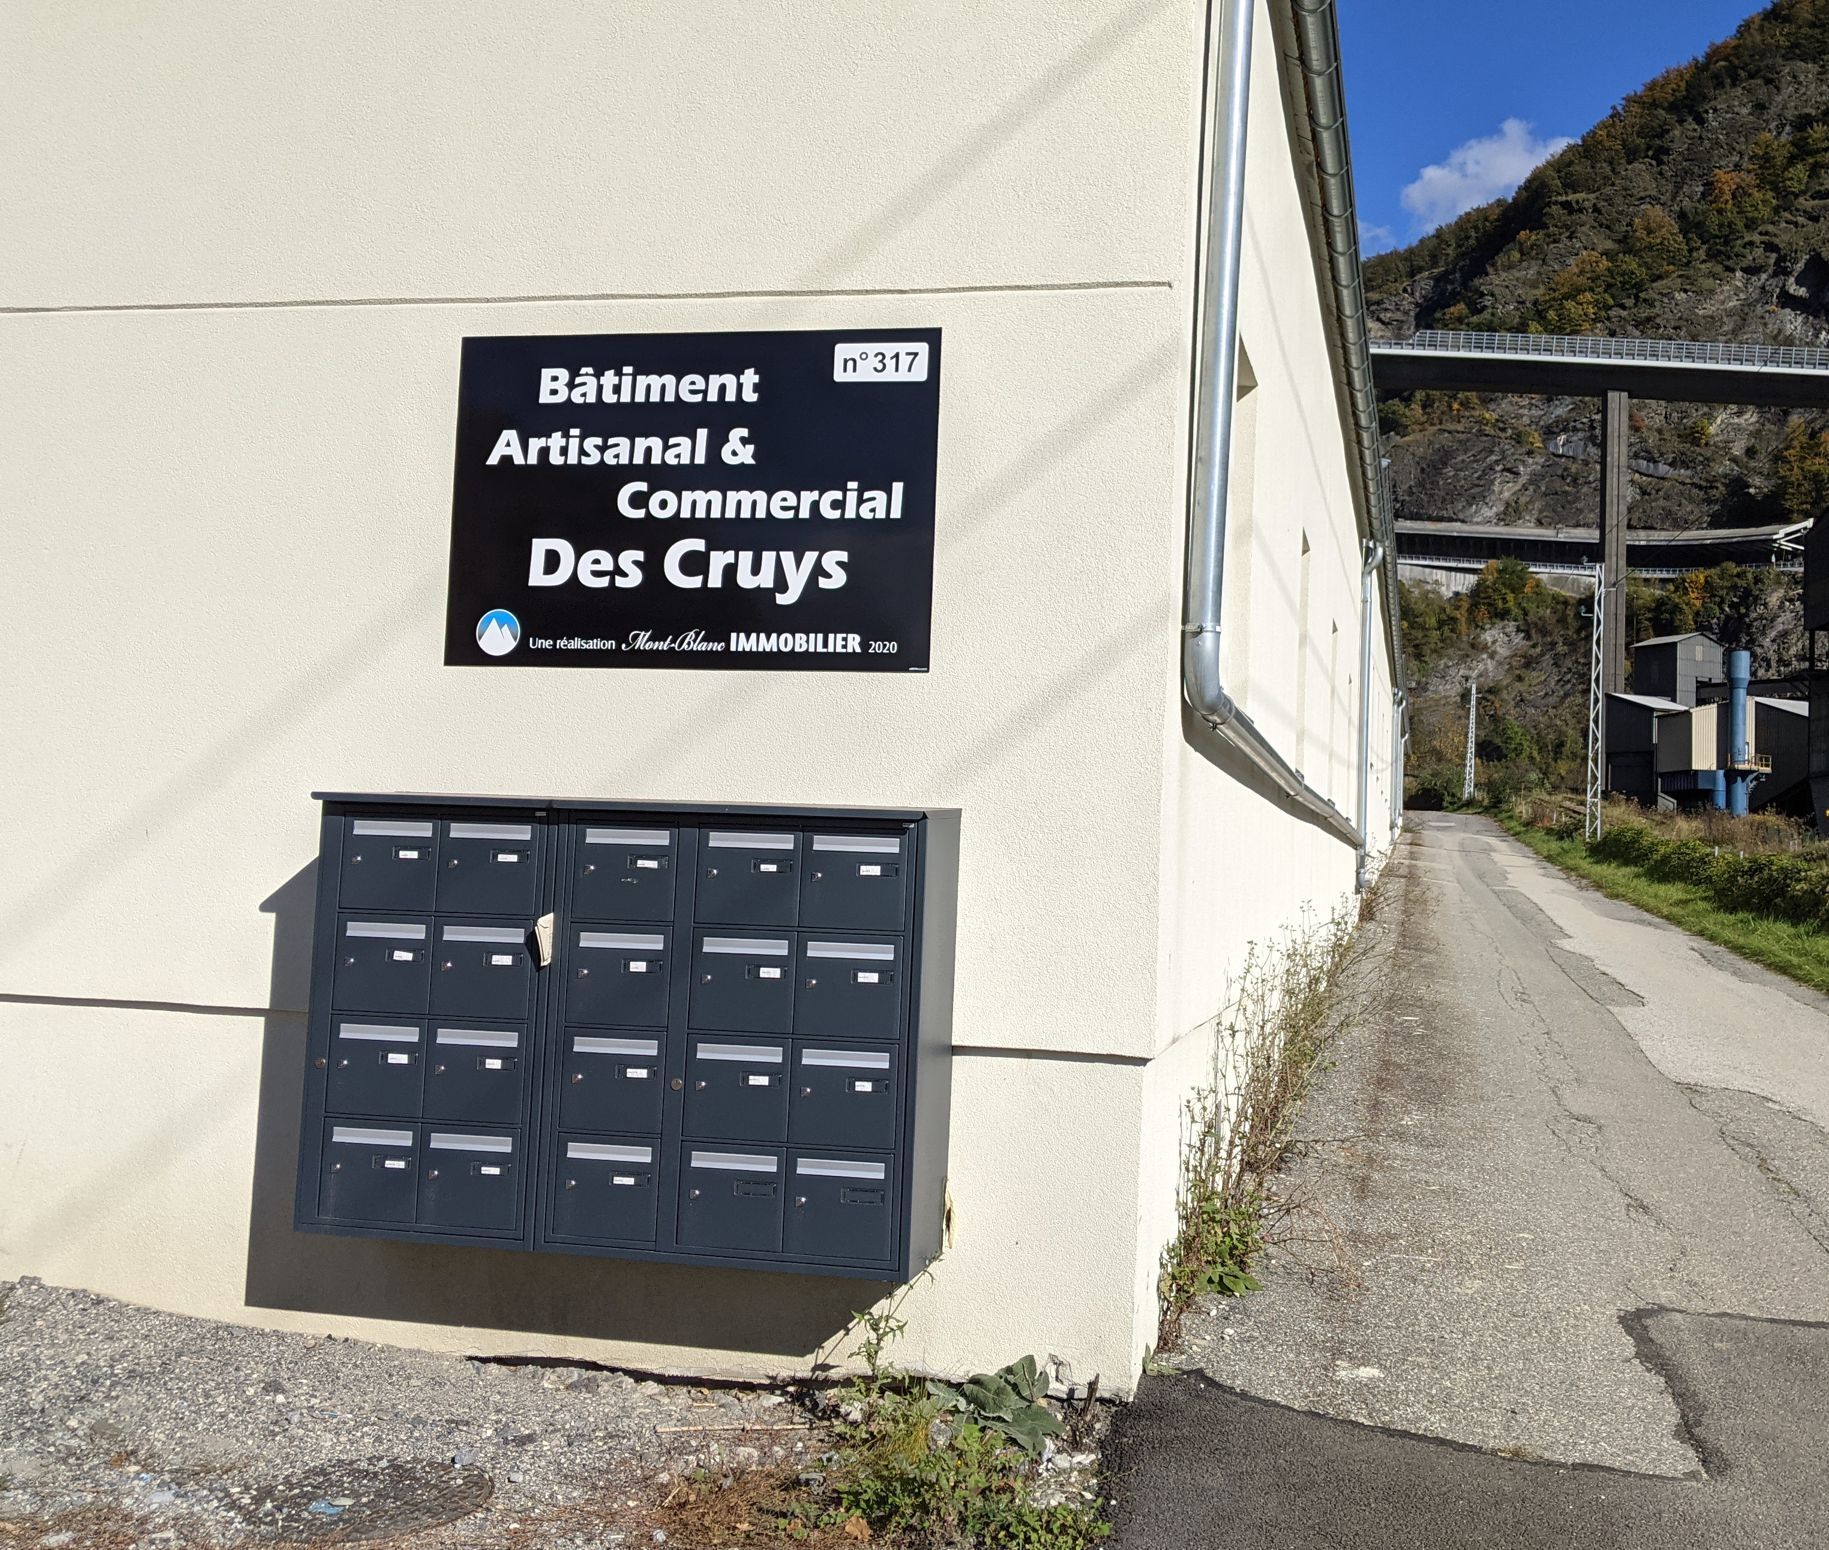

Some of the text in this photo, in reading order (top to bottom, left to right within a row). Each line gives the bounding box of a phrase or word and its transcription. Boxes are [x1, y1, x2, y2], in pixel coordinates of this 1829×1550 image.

[538, 366, 760, 404] Bâtiment
[485, 428, 757, 466] Artisanal &
[616, 480, 905, 520] Commercial
[527, 537, 849, 606] Des Cruys
[529, 628, 898, 654] Une réalisation Mont-Blanc IMMOBILIER 2020
